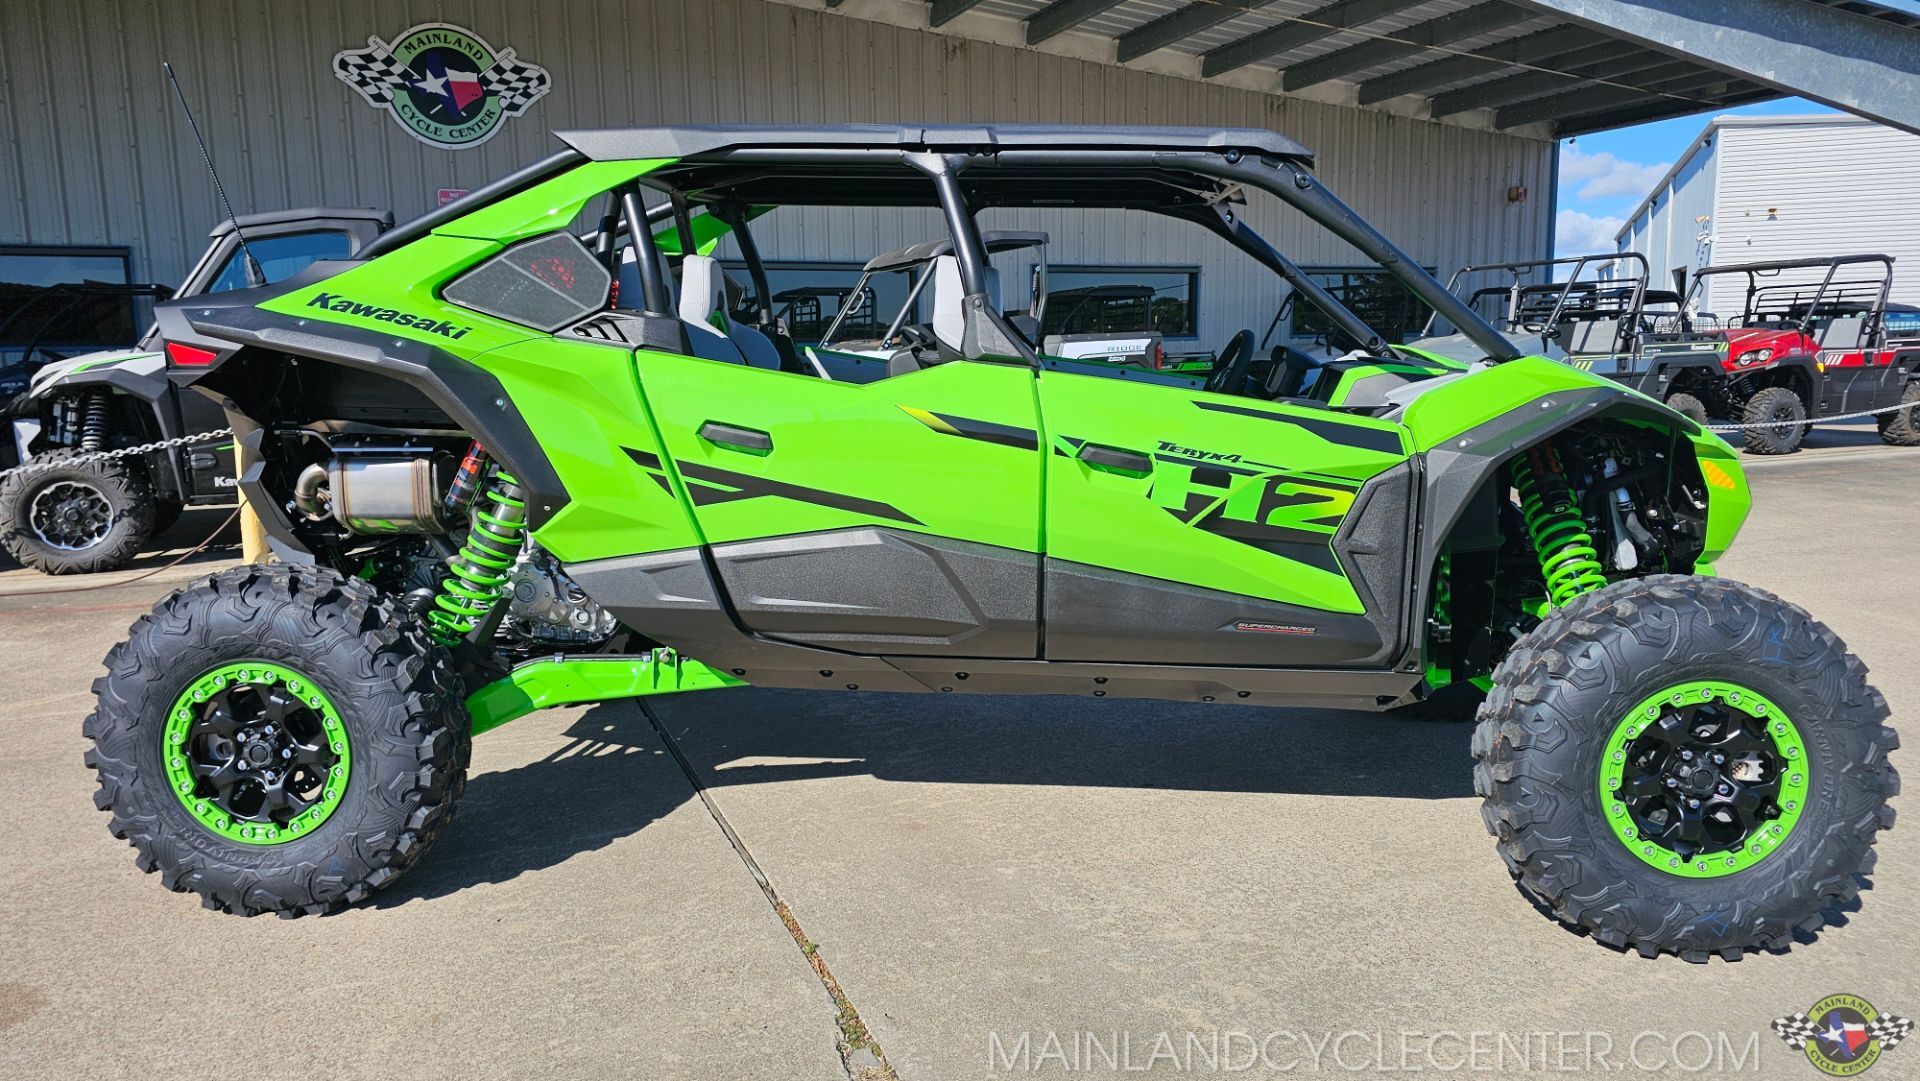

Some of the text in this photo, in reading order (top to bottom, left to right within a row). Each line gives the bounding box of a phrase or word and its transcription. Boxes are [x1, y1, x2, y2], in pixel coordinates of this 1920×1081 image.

[403, 33, 483, 60] MAINLAND
[401, 104, 496, 139] CYCLE CENTER
[306, 292, 473, 340] Kawasaki
[1149, 460, 1357, 535] H2
[1237, 622, 1316, 632] SUPERCHARGED
